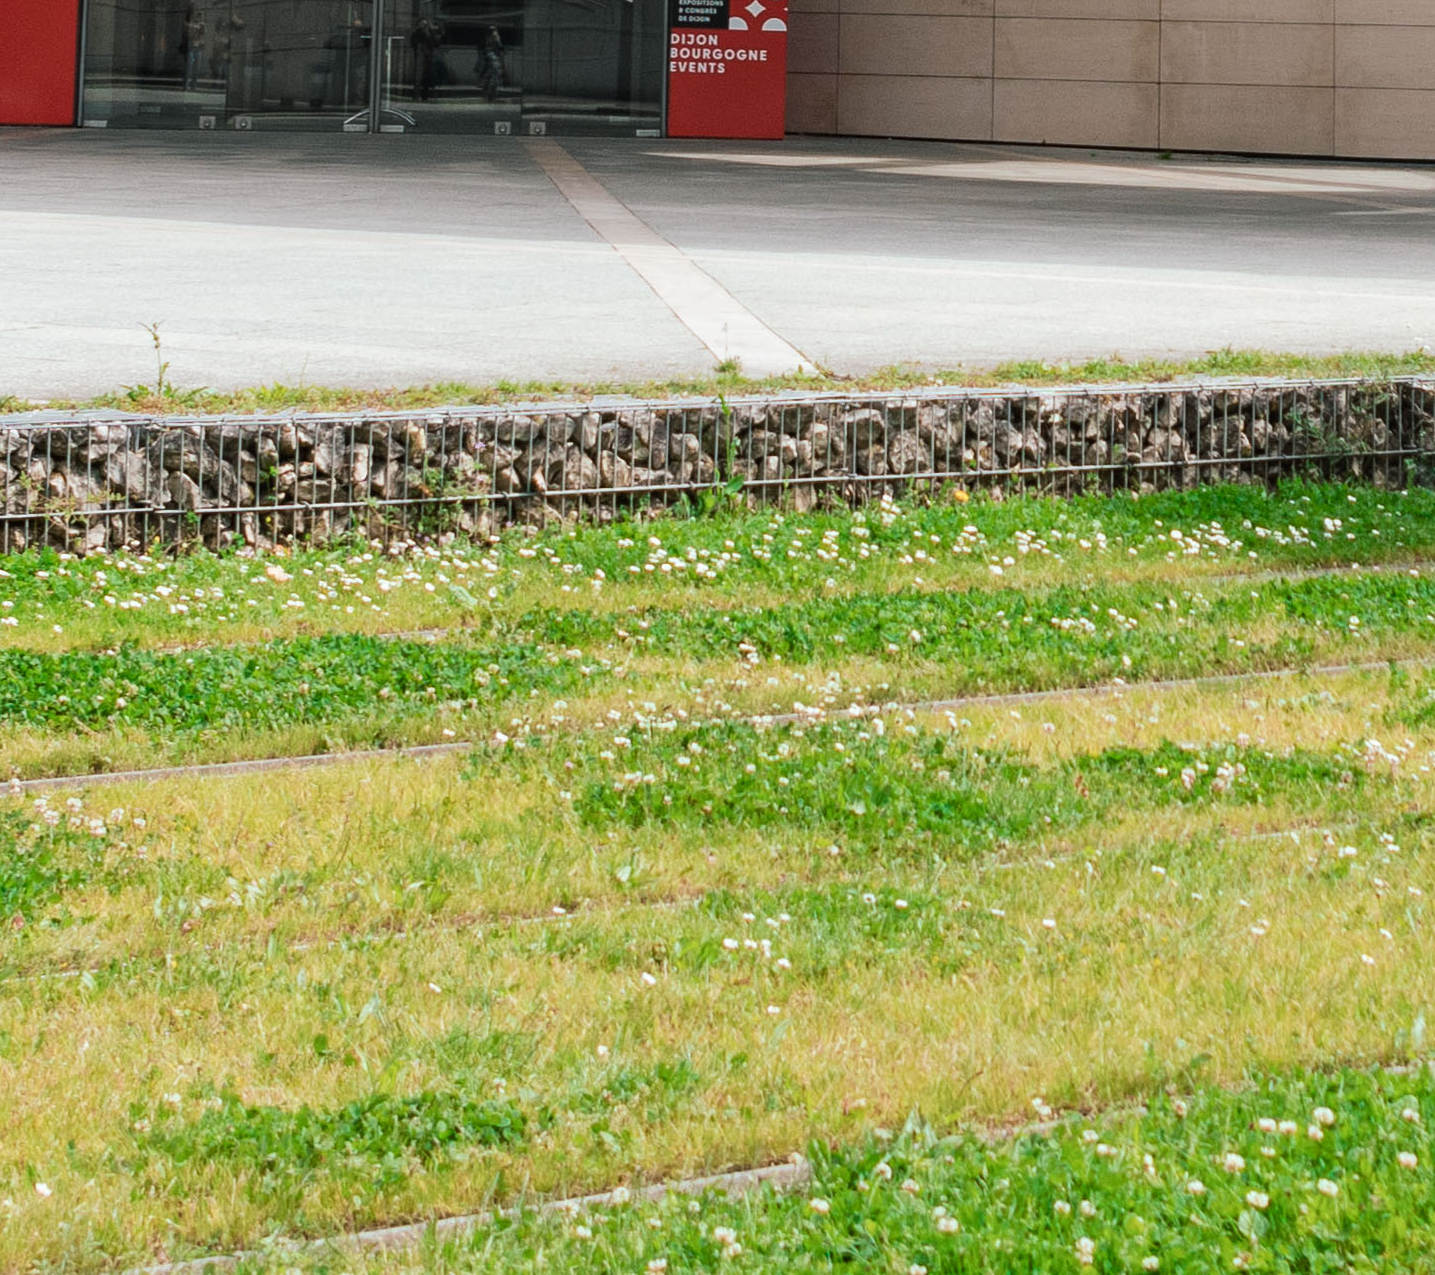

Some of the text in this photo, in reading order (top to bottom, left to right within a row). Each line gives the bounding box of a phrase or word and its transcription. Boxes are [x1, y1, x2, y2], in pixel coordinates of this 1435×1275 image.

[671, 34, 718, 45] DIJON
[670, 48, 768, 61] BOURGOGNE
[670, 62, 725, 73] EVENTS
